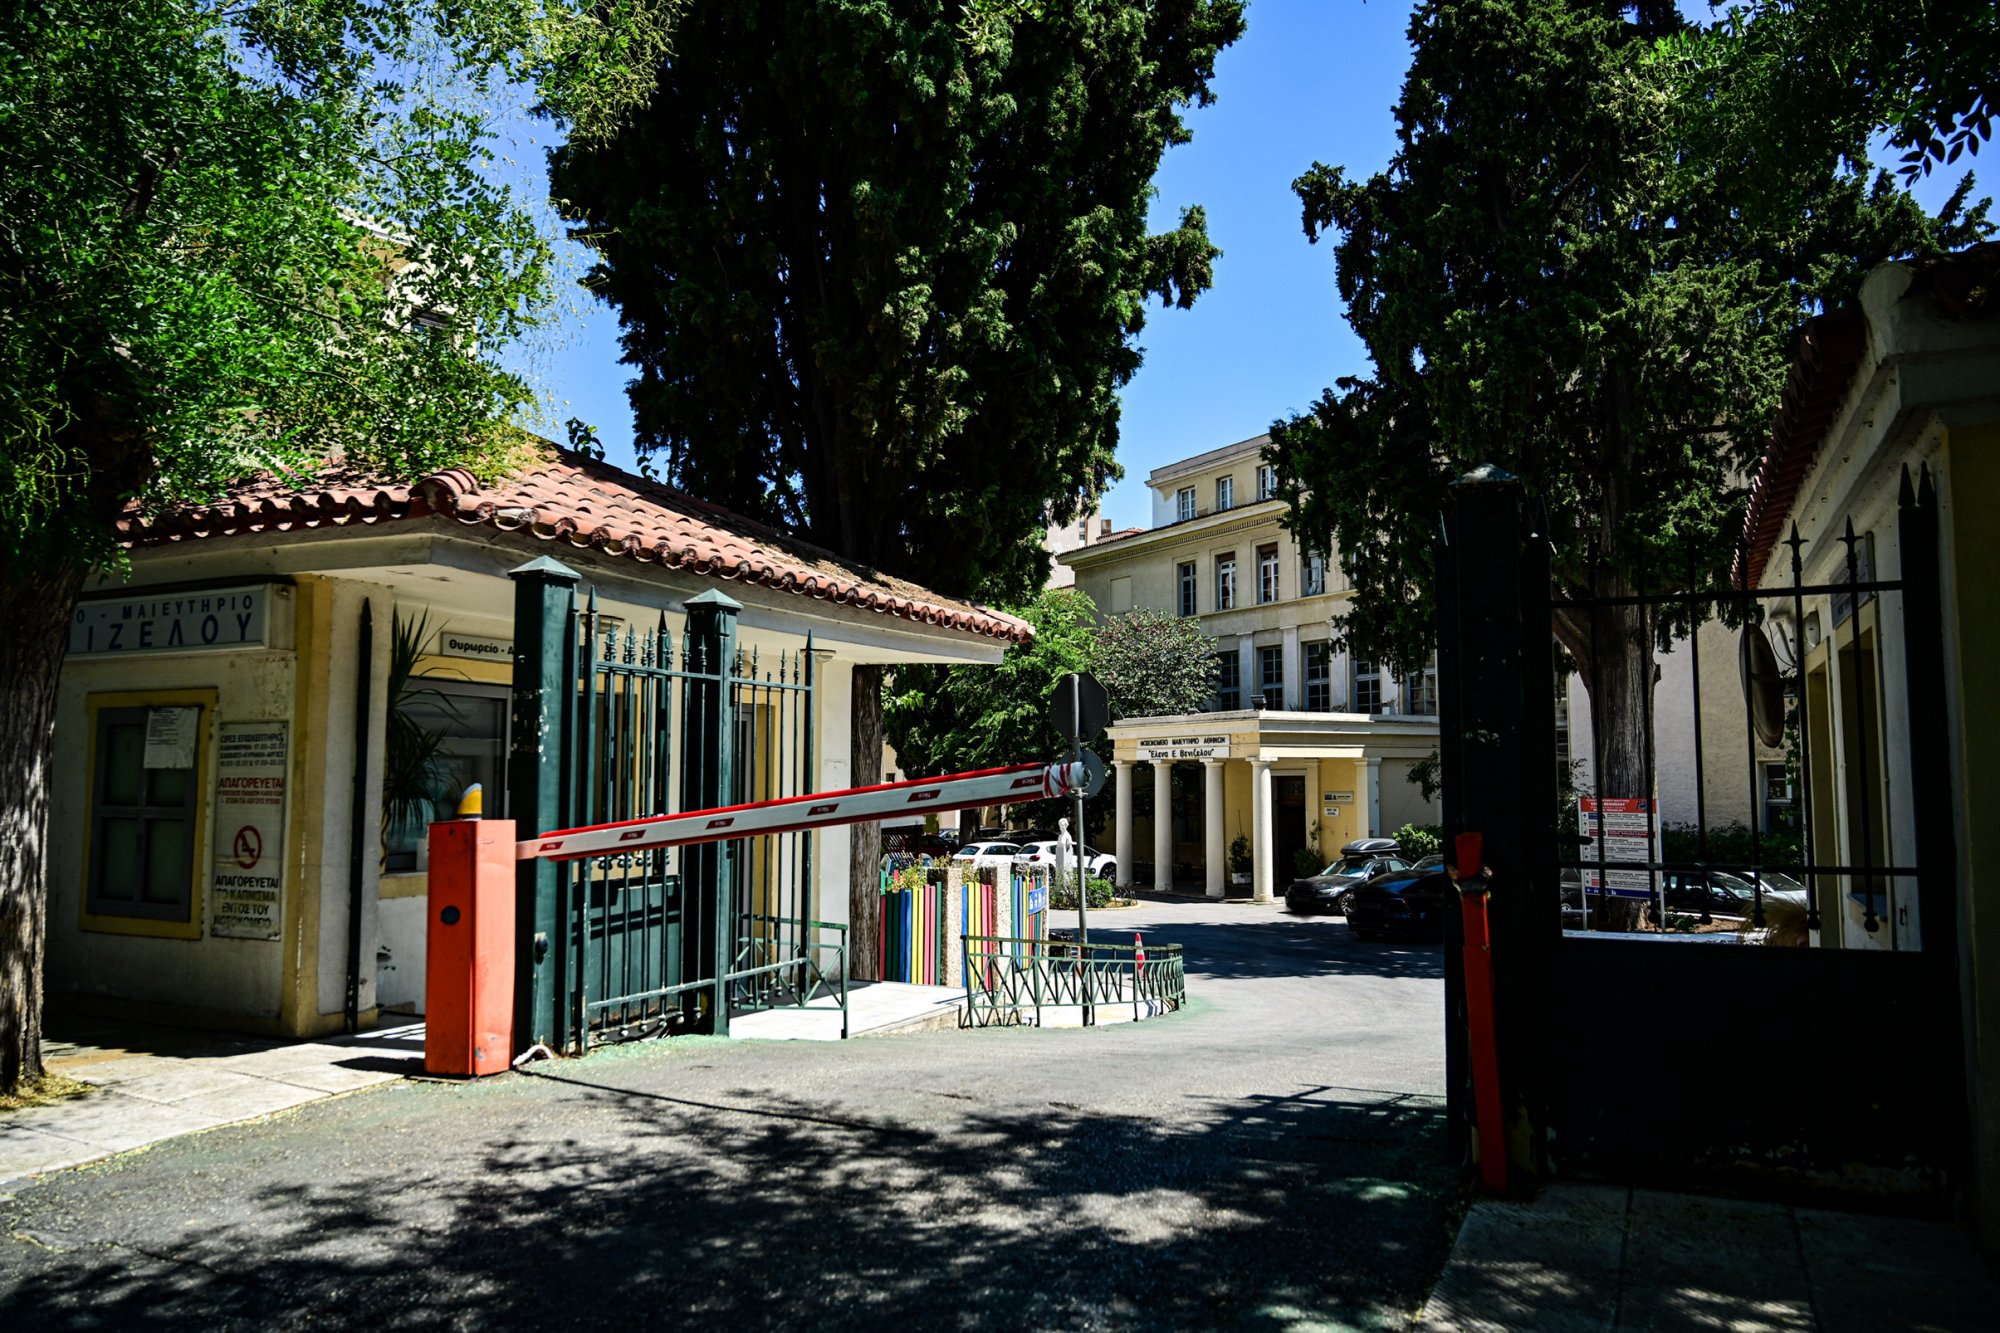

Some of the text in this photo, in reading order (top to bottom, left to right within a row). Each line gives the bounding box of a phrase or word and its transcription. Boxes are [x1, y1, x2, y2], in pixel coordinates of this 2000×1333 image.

[122, 595, 253, 620] ΜΑΙΕΥΤΗΡΙΟ
[66, 613, 252, 651] ΙΖΕΛΟΥ
[449, 639, 499, 654] Θυρωρείο
[219, 777, 284, 788] ΑΠΑΓΟΡΕΥΕΤΑΙ
[215, 875, 279, 888] ΑΠΑΓΟΡΕΥΕΤΑΙ
[252, 904, 270, 915] ΤΟΥ
